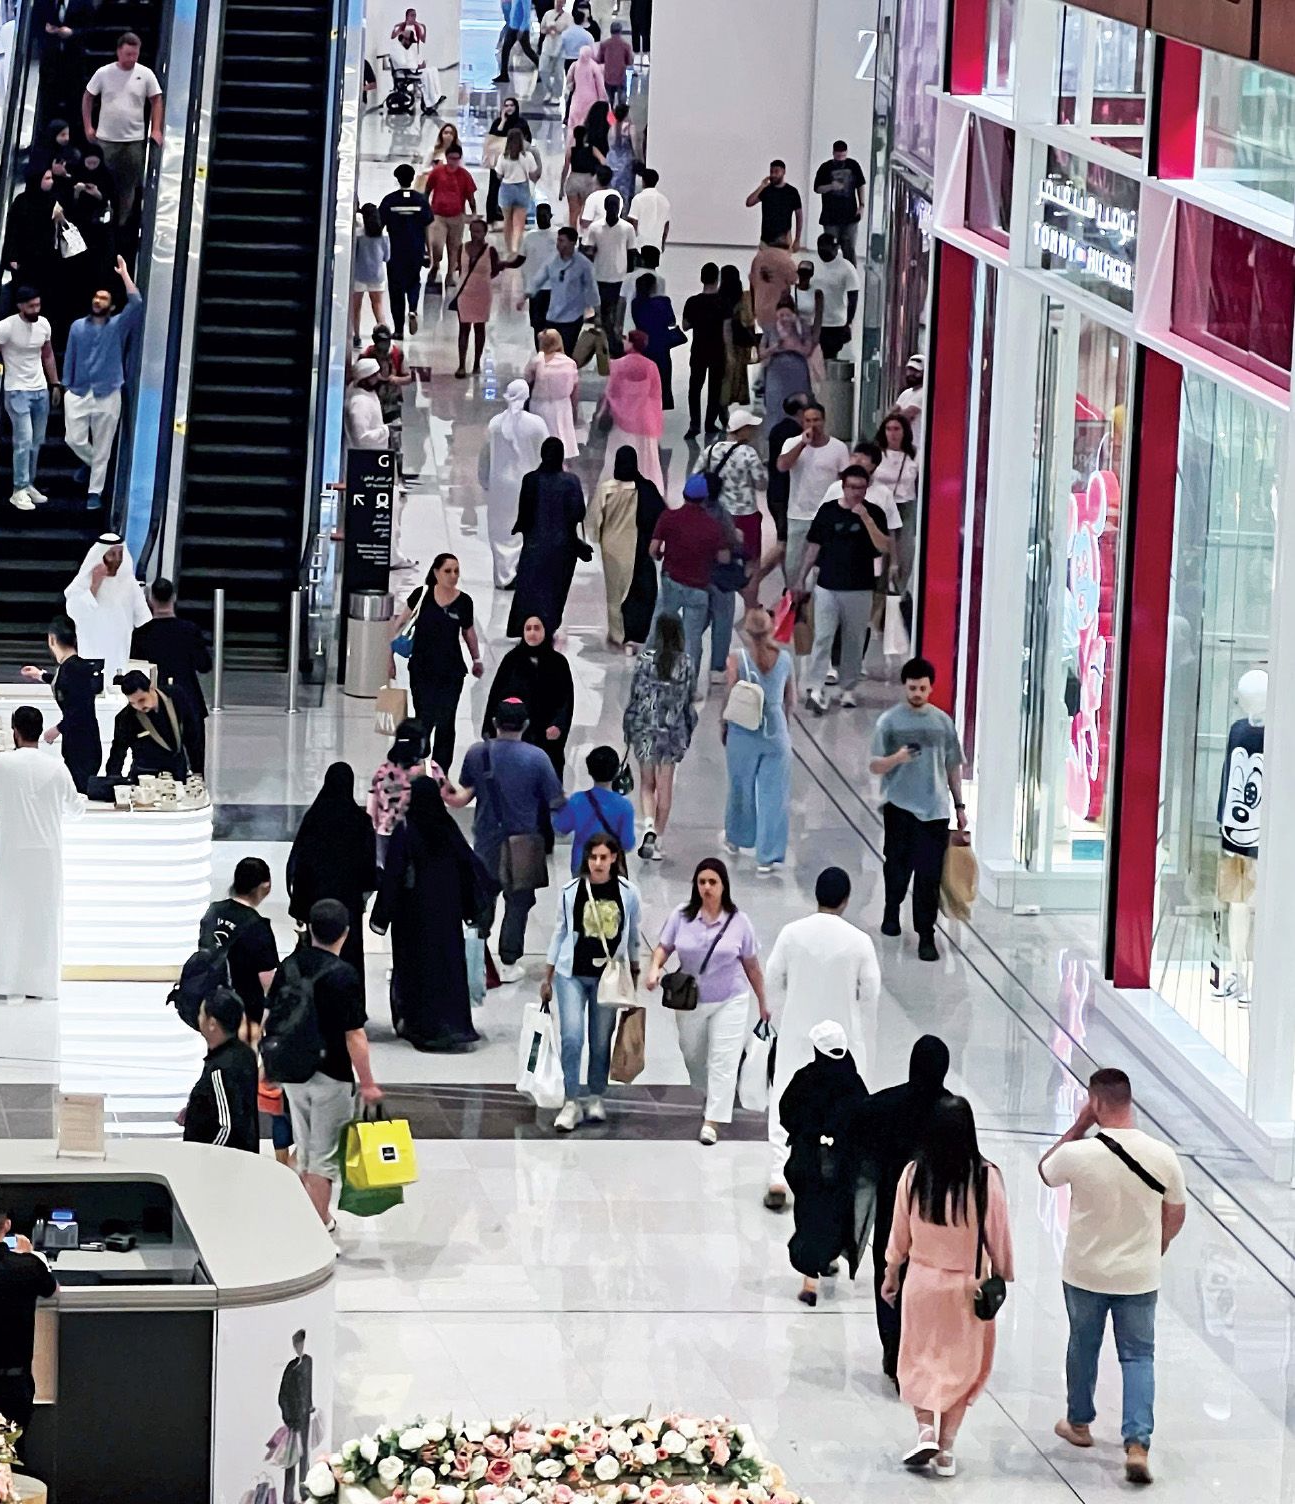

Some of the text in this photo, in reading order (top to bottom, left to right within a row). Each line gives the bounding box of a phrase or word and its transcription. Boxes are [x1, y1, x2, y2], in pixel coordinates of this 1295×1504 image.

[1033, 220, 1132, 291] TOMMY HILFIGER
[378, 454, 390, 468] G
